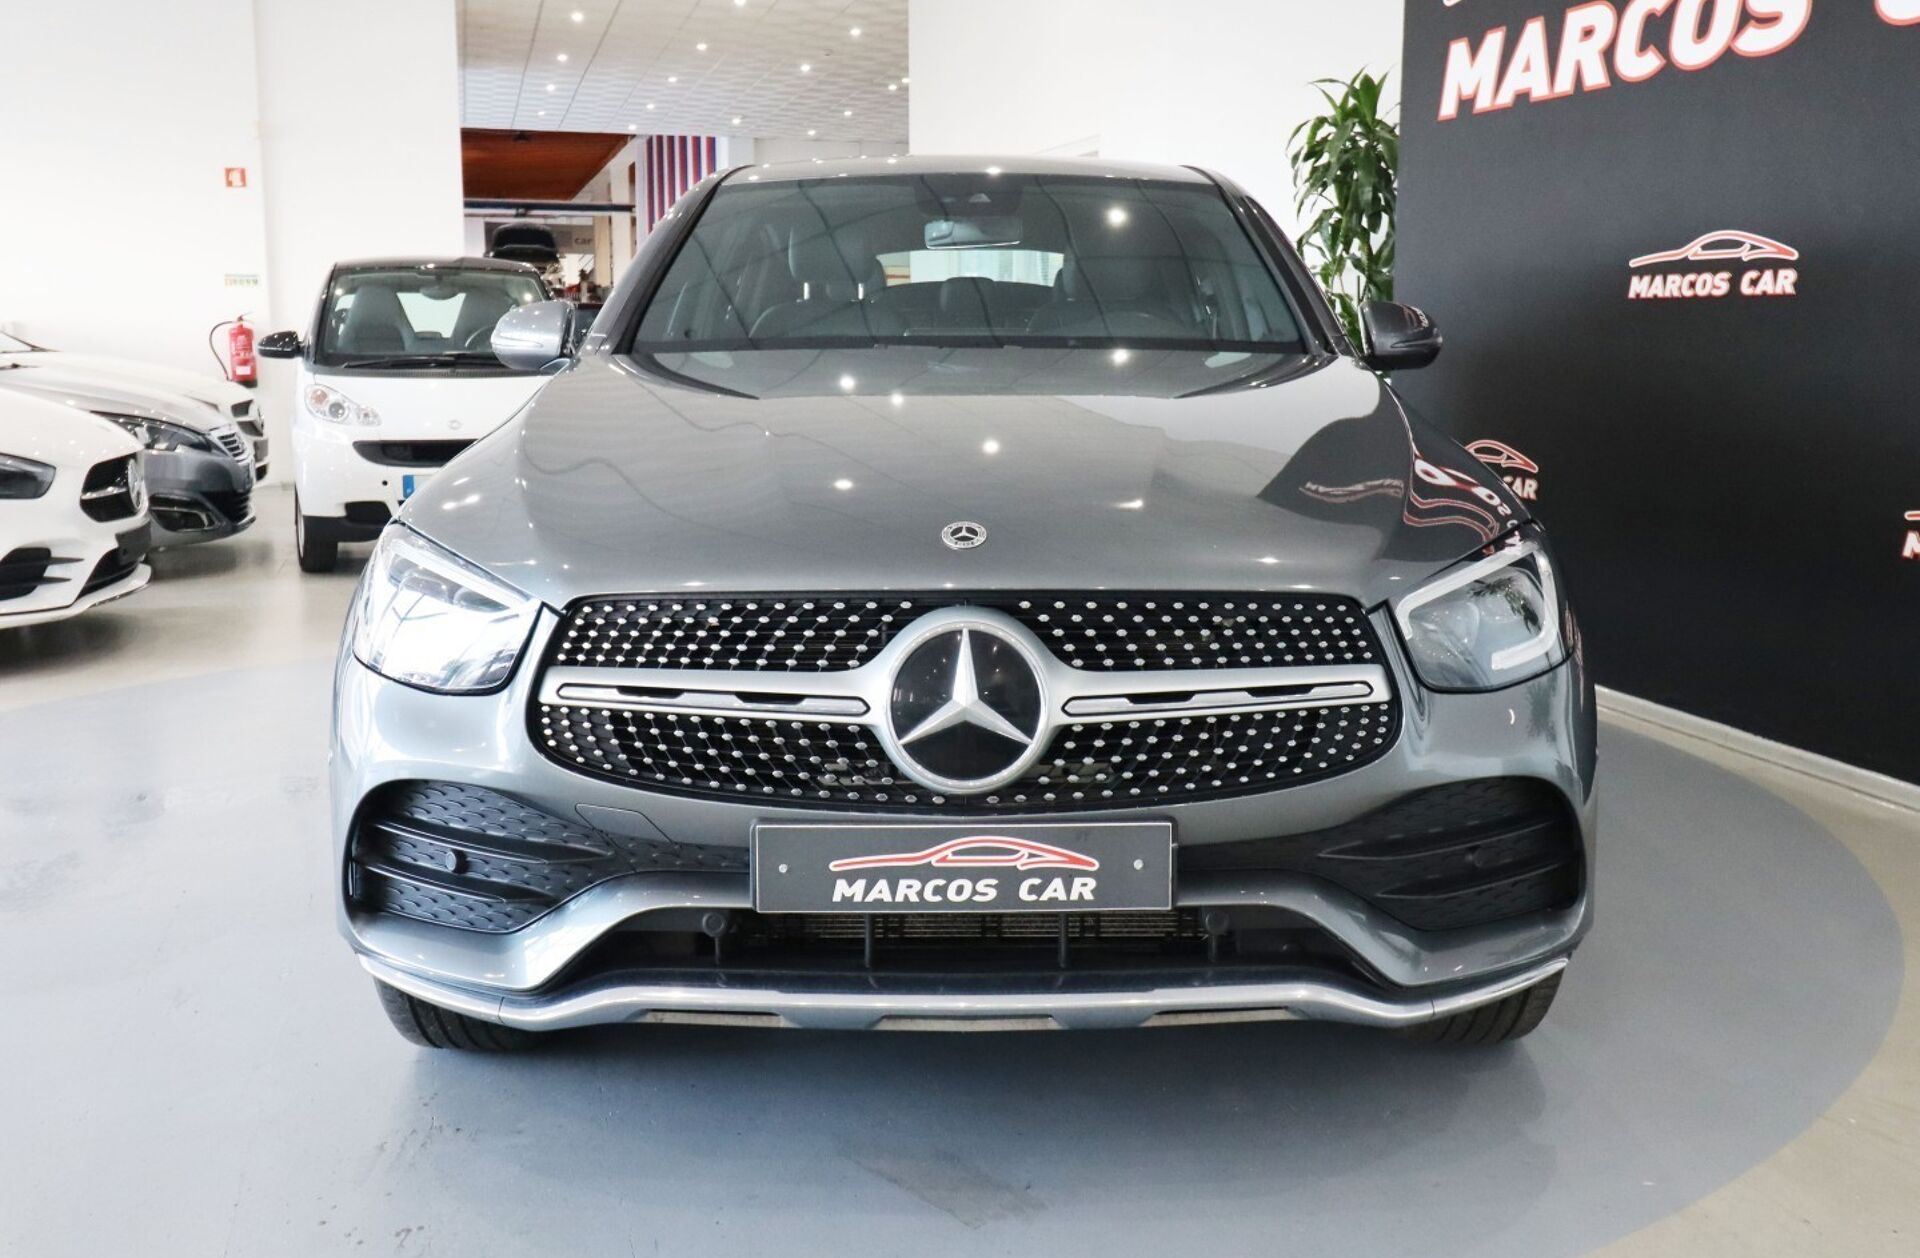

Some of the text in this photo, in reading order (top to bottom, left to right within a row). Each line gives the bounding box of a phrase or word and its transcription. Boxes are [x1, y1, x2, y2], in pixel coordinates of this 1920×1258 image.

[1437, 0, 1812, 121] MARCOS
[1628, 267, 1797, 299] MARCOS CAR
[1503, 475, 1538, 500] AR
[832, 877, 1097, 902] MARCOS CAR
